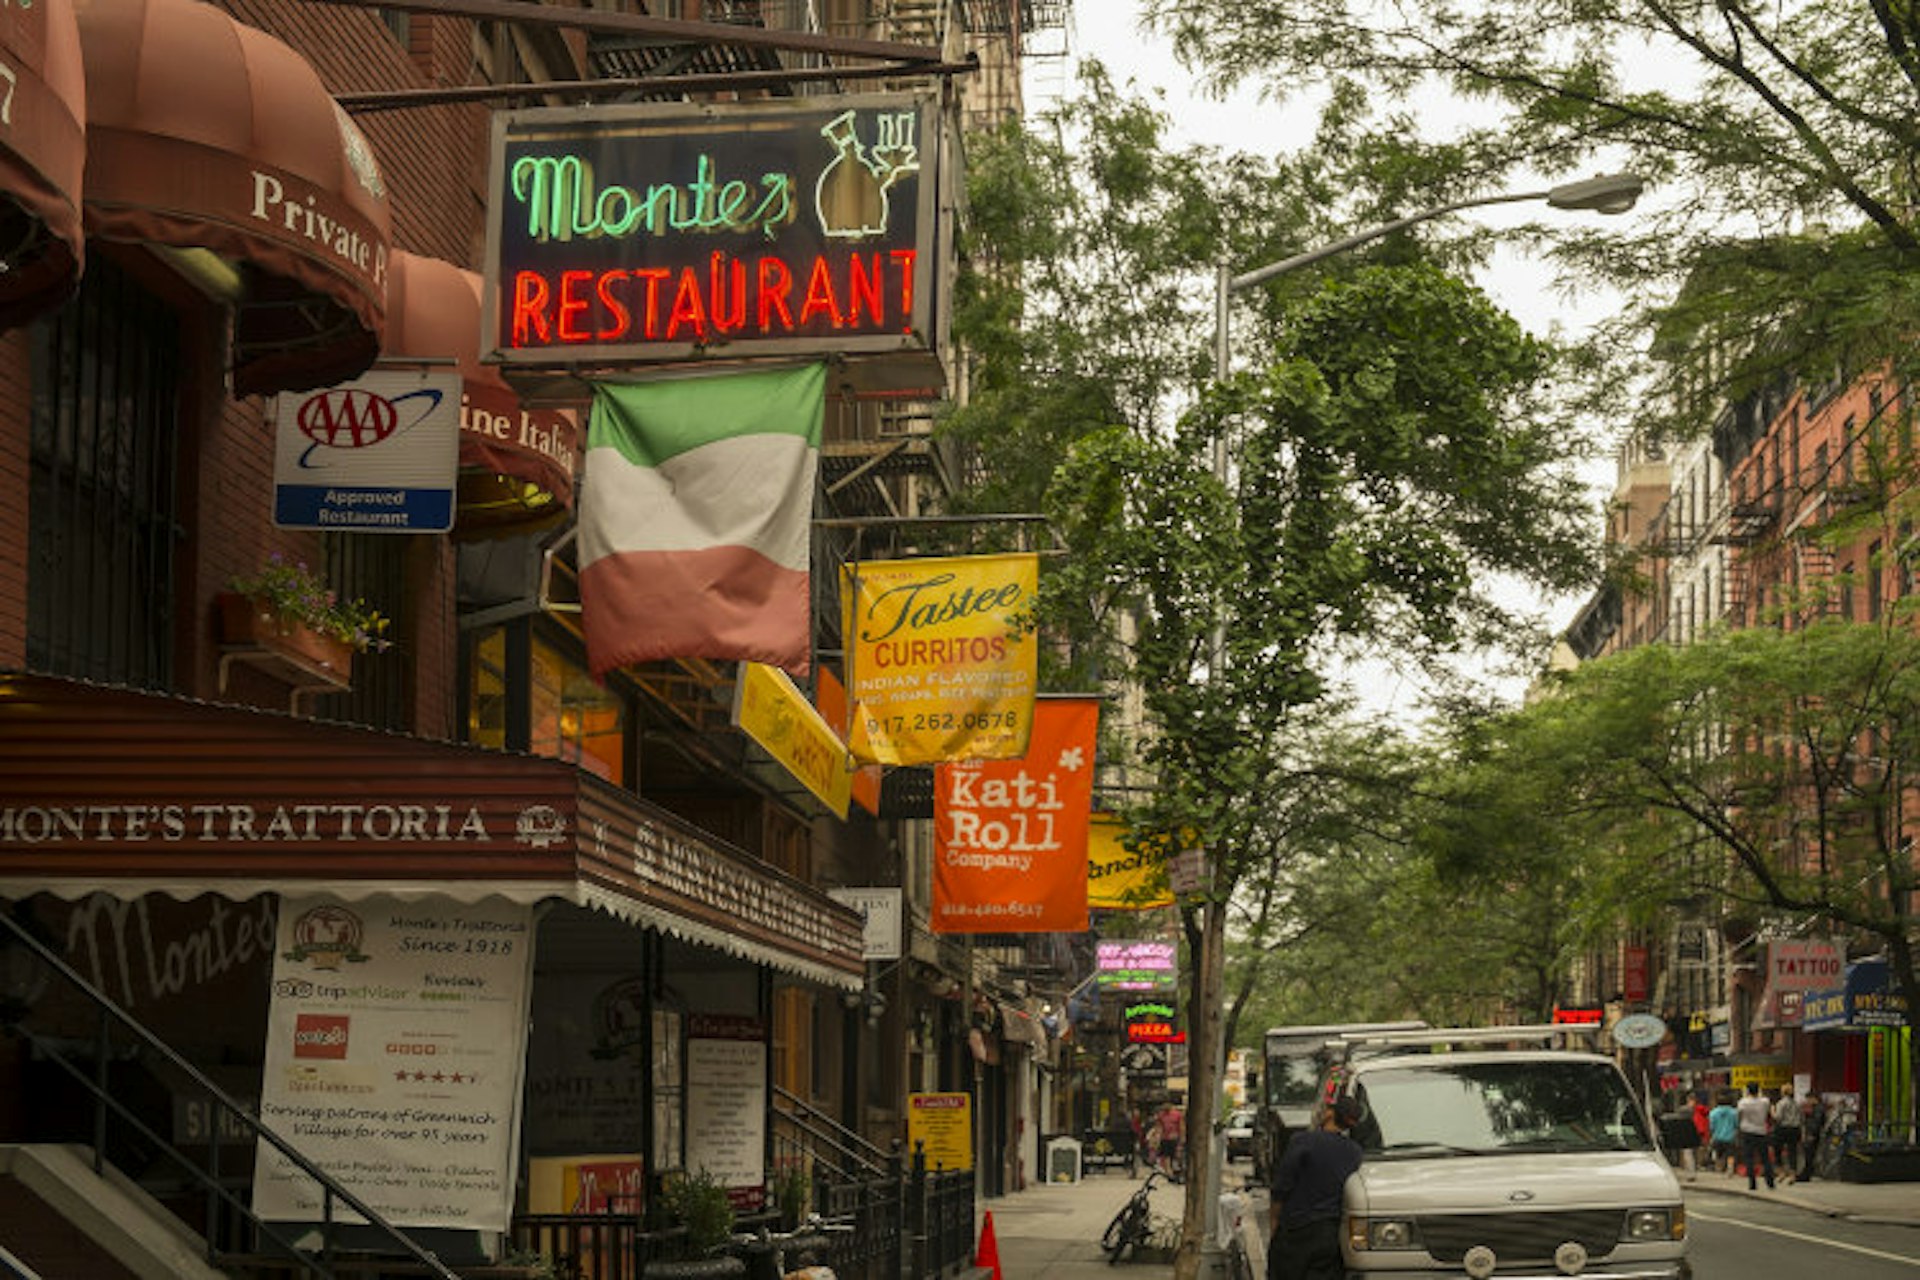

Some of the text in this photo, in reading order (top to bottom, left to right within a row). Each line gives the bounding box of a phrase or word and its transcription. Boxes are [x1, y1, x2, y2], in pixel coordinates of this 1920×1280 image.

[251, 170, 370, 270] Private
[512, 250, 917, 350] RESTAURANT
[306, 391, 392, 447] AAA
[324, 489, 405, 507] Approved
[318, 507, 409, 526] Restaurant
[861, 573, 1022, 643] Tastee
[874, 636, 1006, 669] CURRITOS
[950, 769, 1064, 810] Kati
[191, 806, 492, 842] TRATTORIA
[947, 811, 1061, 851] Roll
[947, 851, 1032, 871] Company
[400, 937, 513, 955] Since 1918
[1776, 959, 1840, 975] TATTOO
[293, 1123, 352, 1139] Village
[353, 1123, 379, 1140] for
[394, 1108, 411, 1124] of
